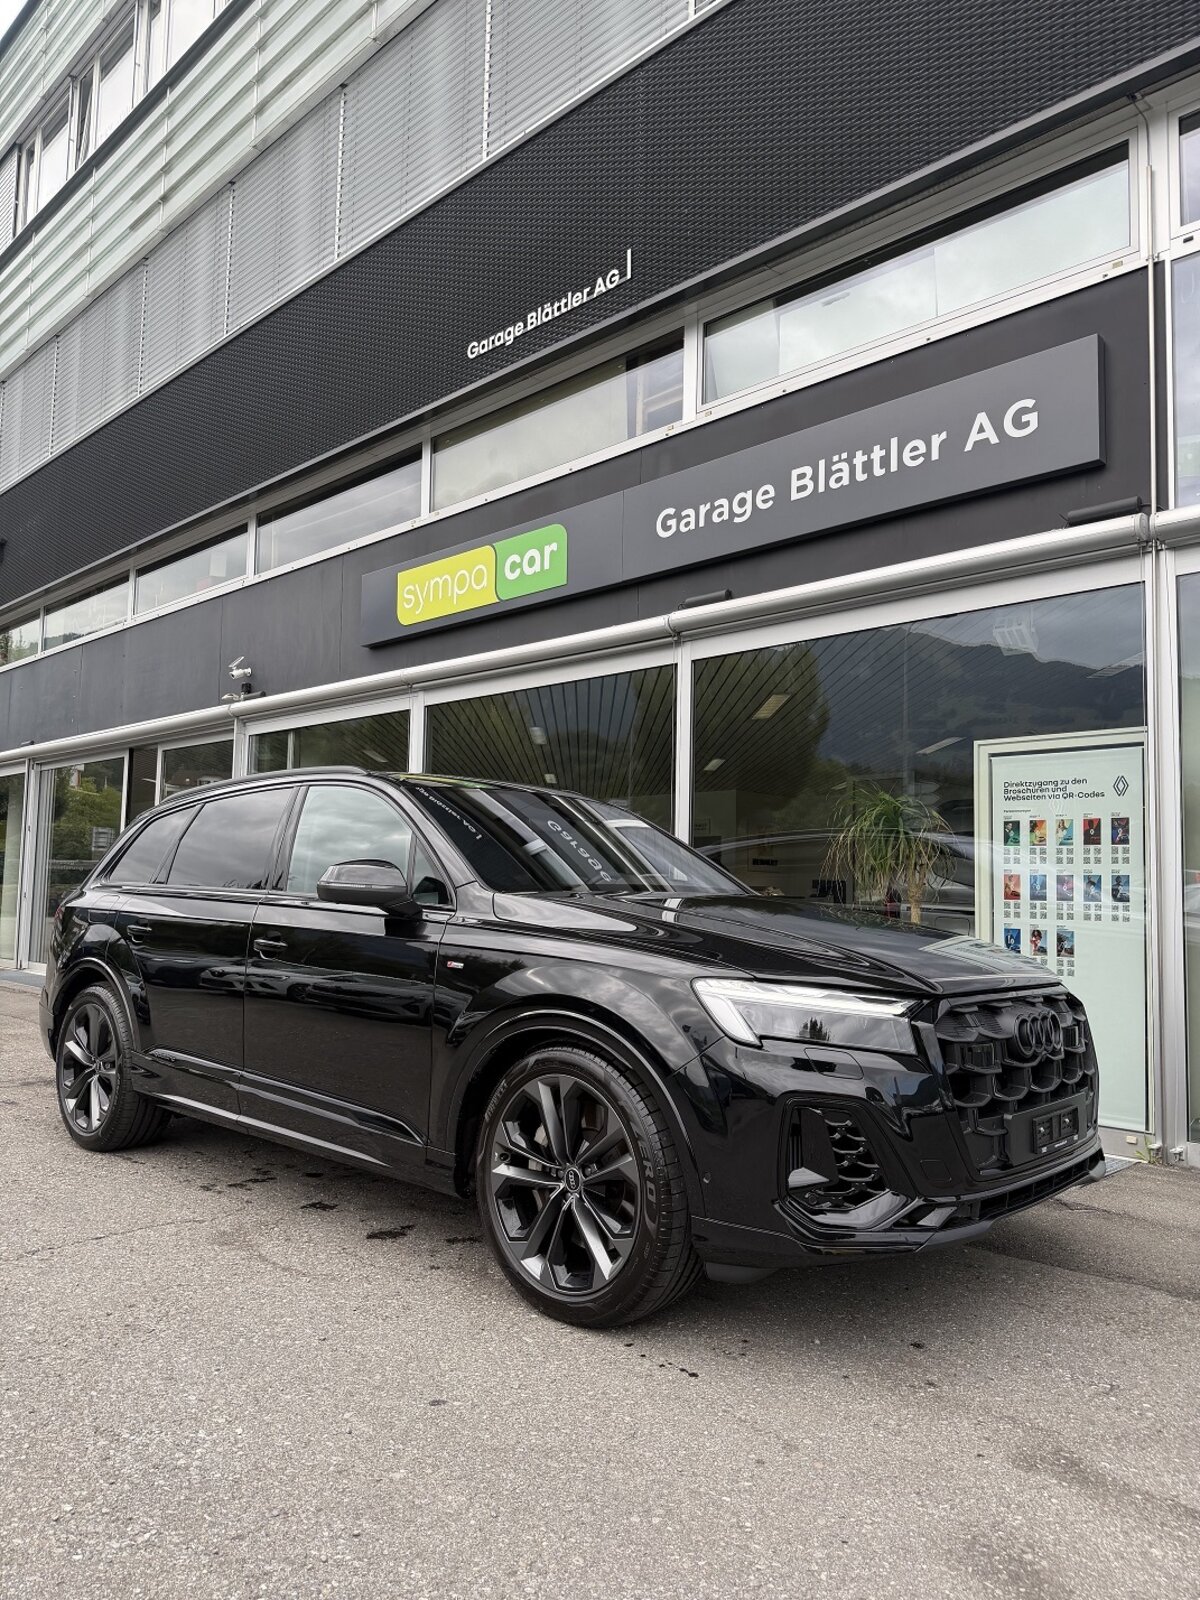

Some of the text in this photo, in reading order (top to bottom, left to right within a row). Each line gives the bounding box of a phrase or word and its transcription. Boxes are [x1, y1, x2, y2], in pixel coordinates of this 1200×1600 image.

[467, 269, 620, 359] Garage Blättler AG
[655, 398, 1039, 539] Garage Blättler AG
[403, 542, 558, 615] sympa car
[1003, 780, 1059, 789] Direktzugang
[1071, 777, 1088, 785] den
[1003, 793, 1047, 802] Webseiten
[1051, 785, 1068, 793] und
